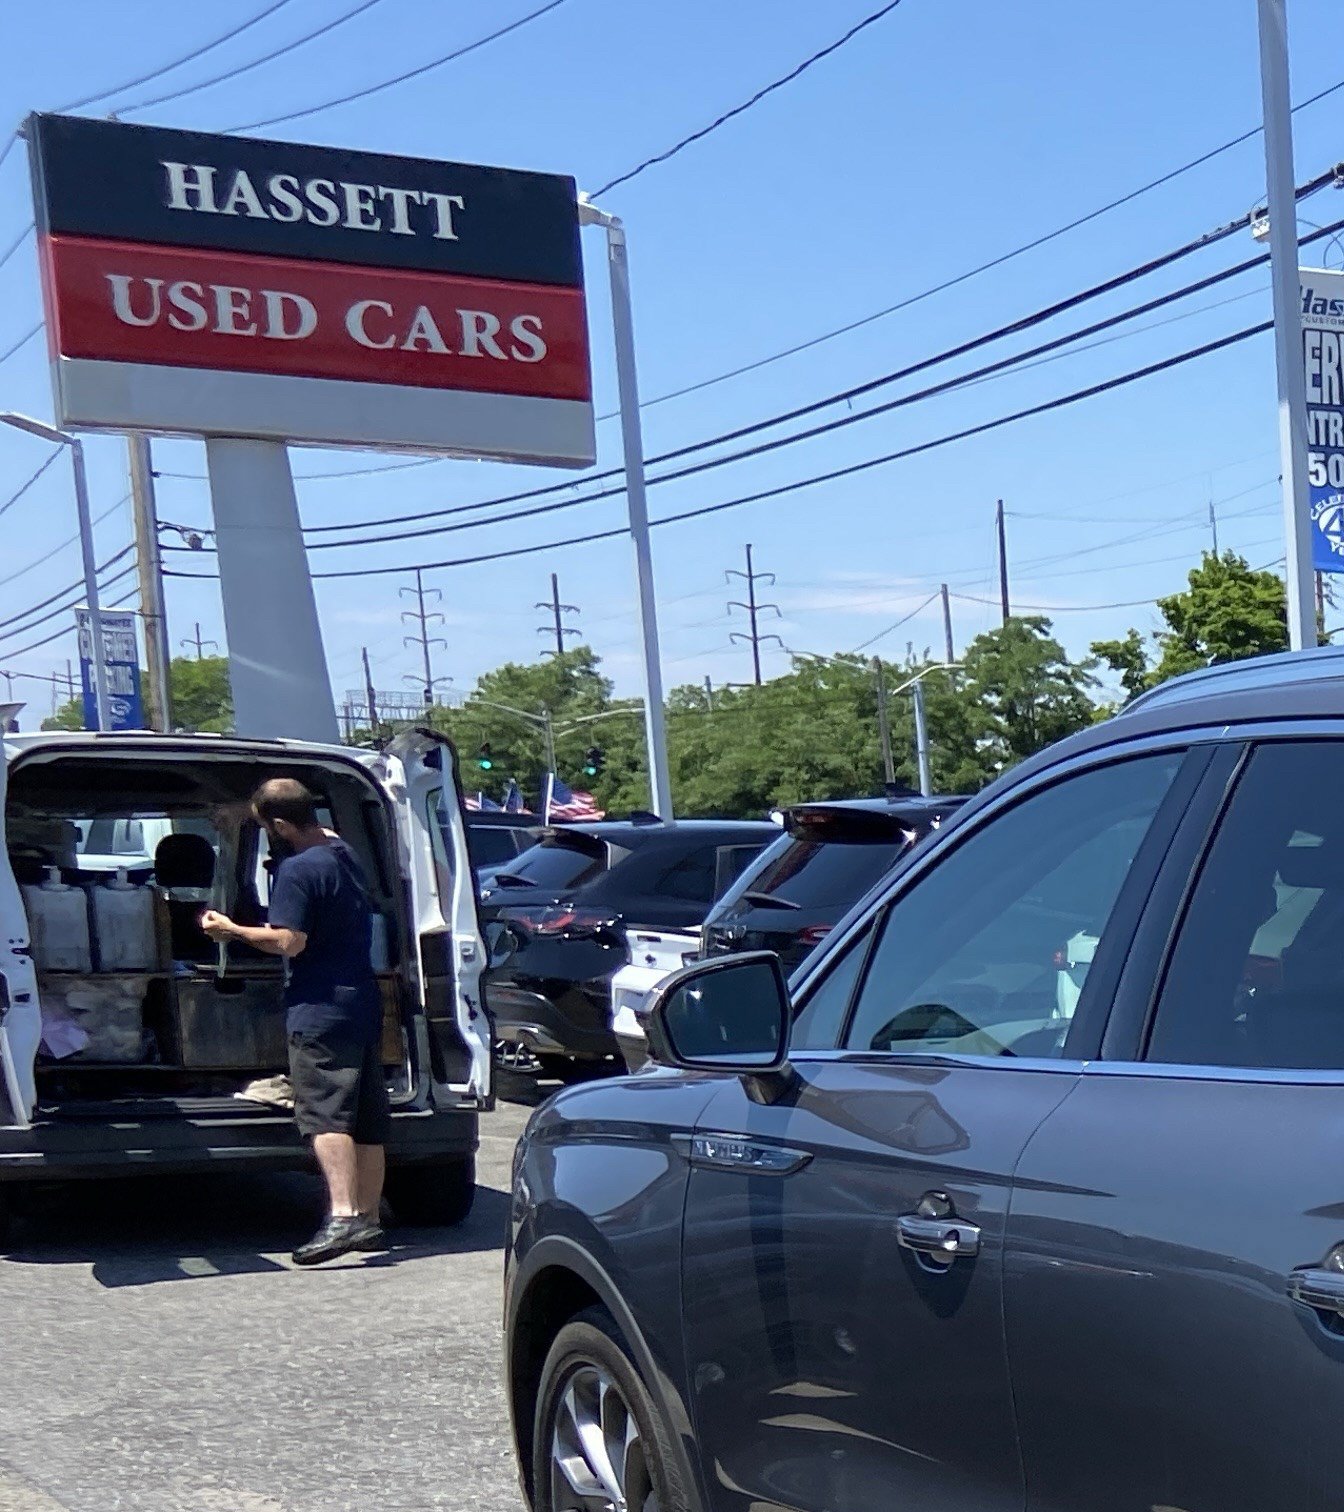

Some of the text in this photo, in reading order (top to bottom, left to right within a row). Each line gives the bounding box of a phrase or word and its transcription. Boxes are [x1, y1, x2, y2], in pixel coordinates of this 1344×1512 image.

[160, 161, 465, 240] HASSETT
[106, 274, 548, 364] USED CARS
